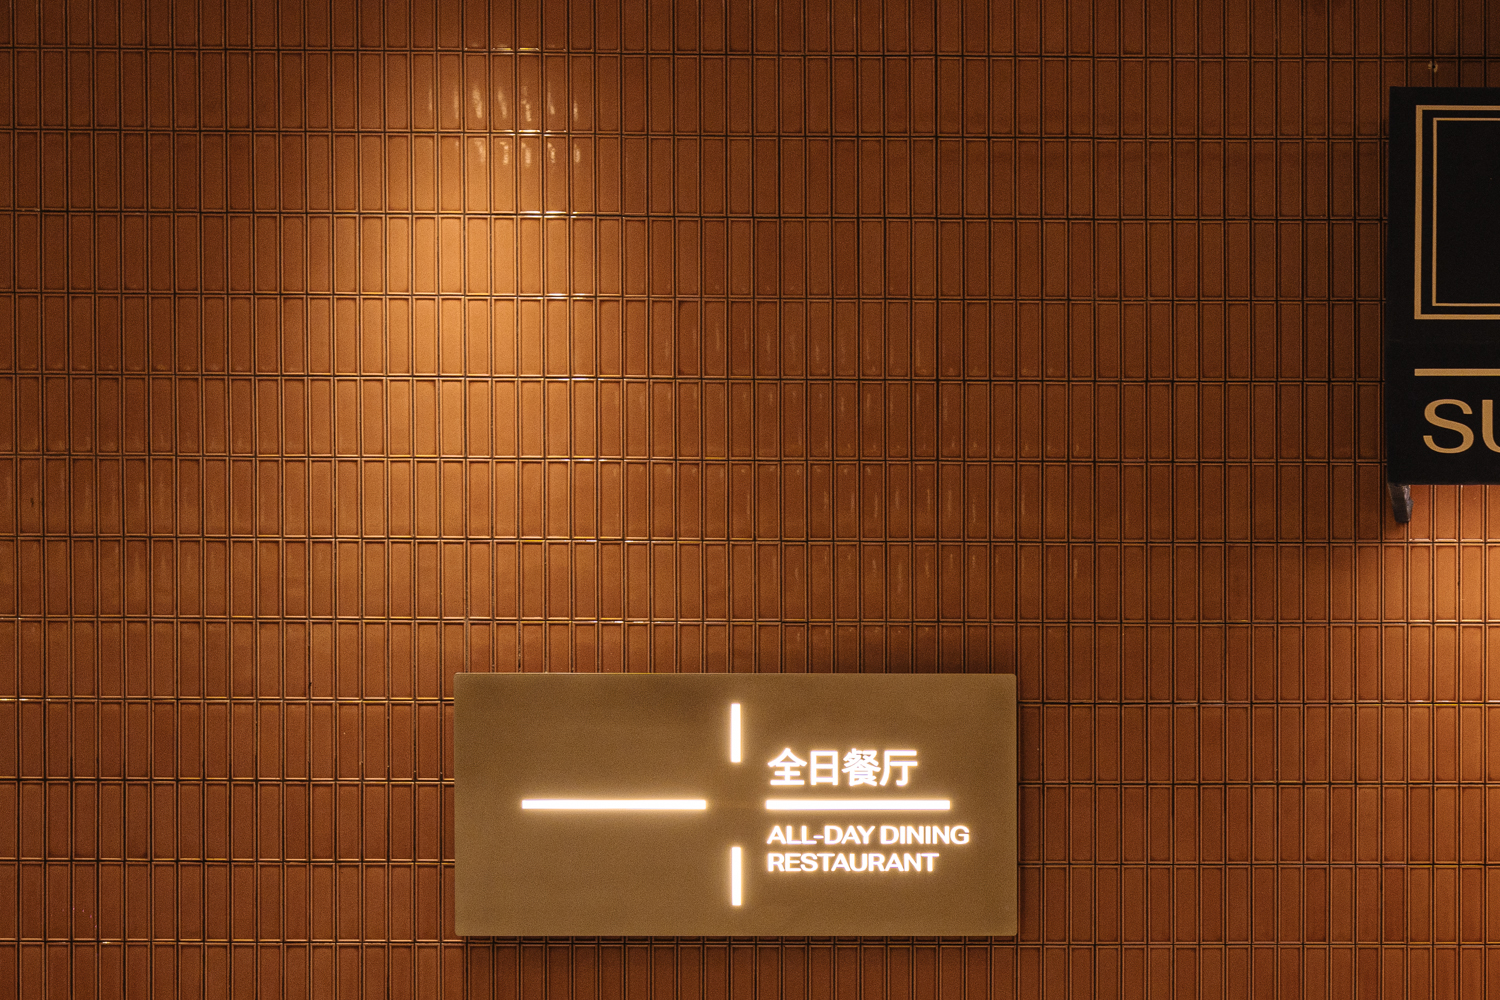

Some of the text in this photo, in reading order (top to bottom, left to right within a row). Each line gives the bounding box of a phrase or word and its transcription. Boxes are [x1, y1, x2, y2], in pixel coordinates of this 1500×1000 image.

[767, 747, 918, 787] 全日餐厅
[766, 825, 970, 845] ALL-DAY DINING
[767, 852, 940, 872] RESTAURANT
